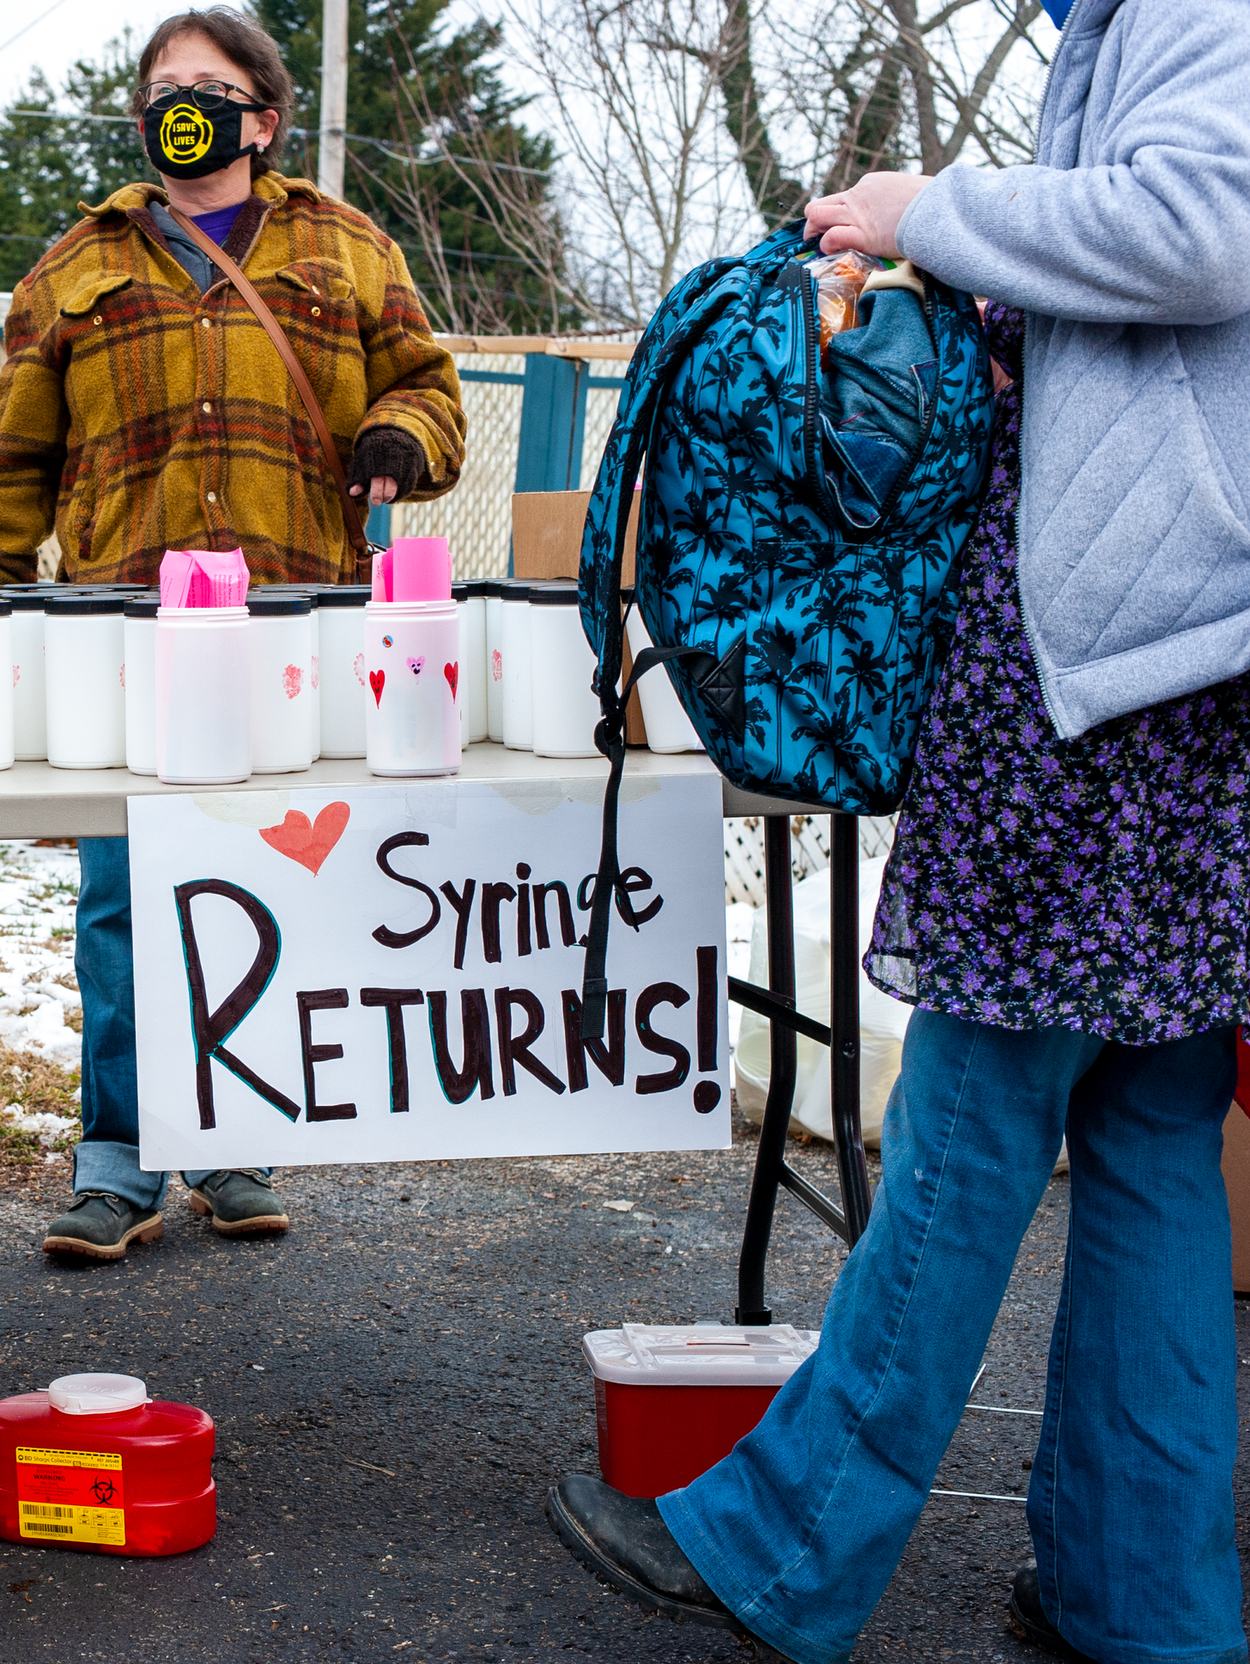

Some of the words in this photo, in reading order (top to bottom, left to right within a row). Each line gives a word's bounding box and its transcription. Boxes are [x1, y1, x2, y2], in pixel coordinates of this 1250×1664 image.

[173, 124, 176, 132] I
[176, 123, 196, 132] SAVE
[174, 136, 195, 146] LIVES
[173, 878, 722, 1130] RETURNS!
